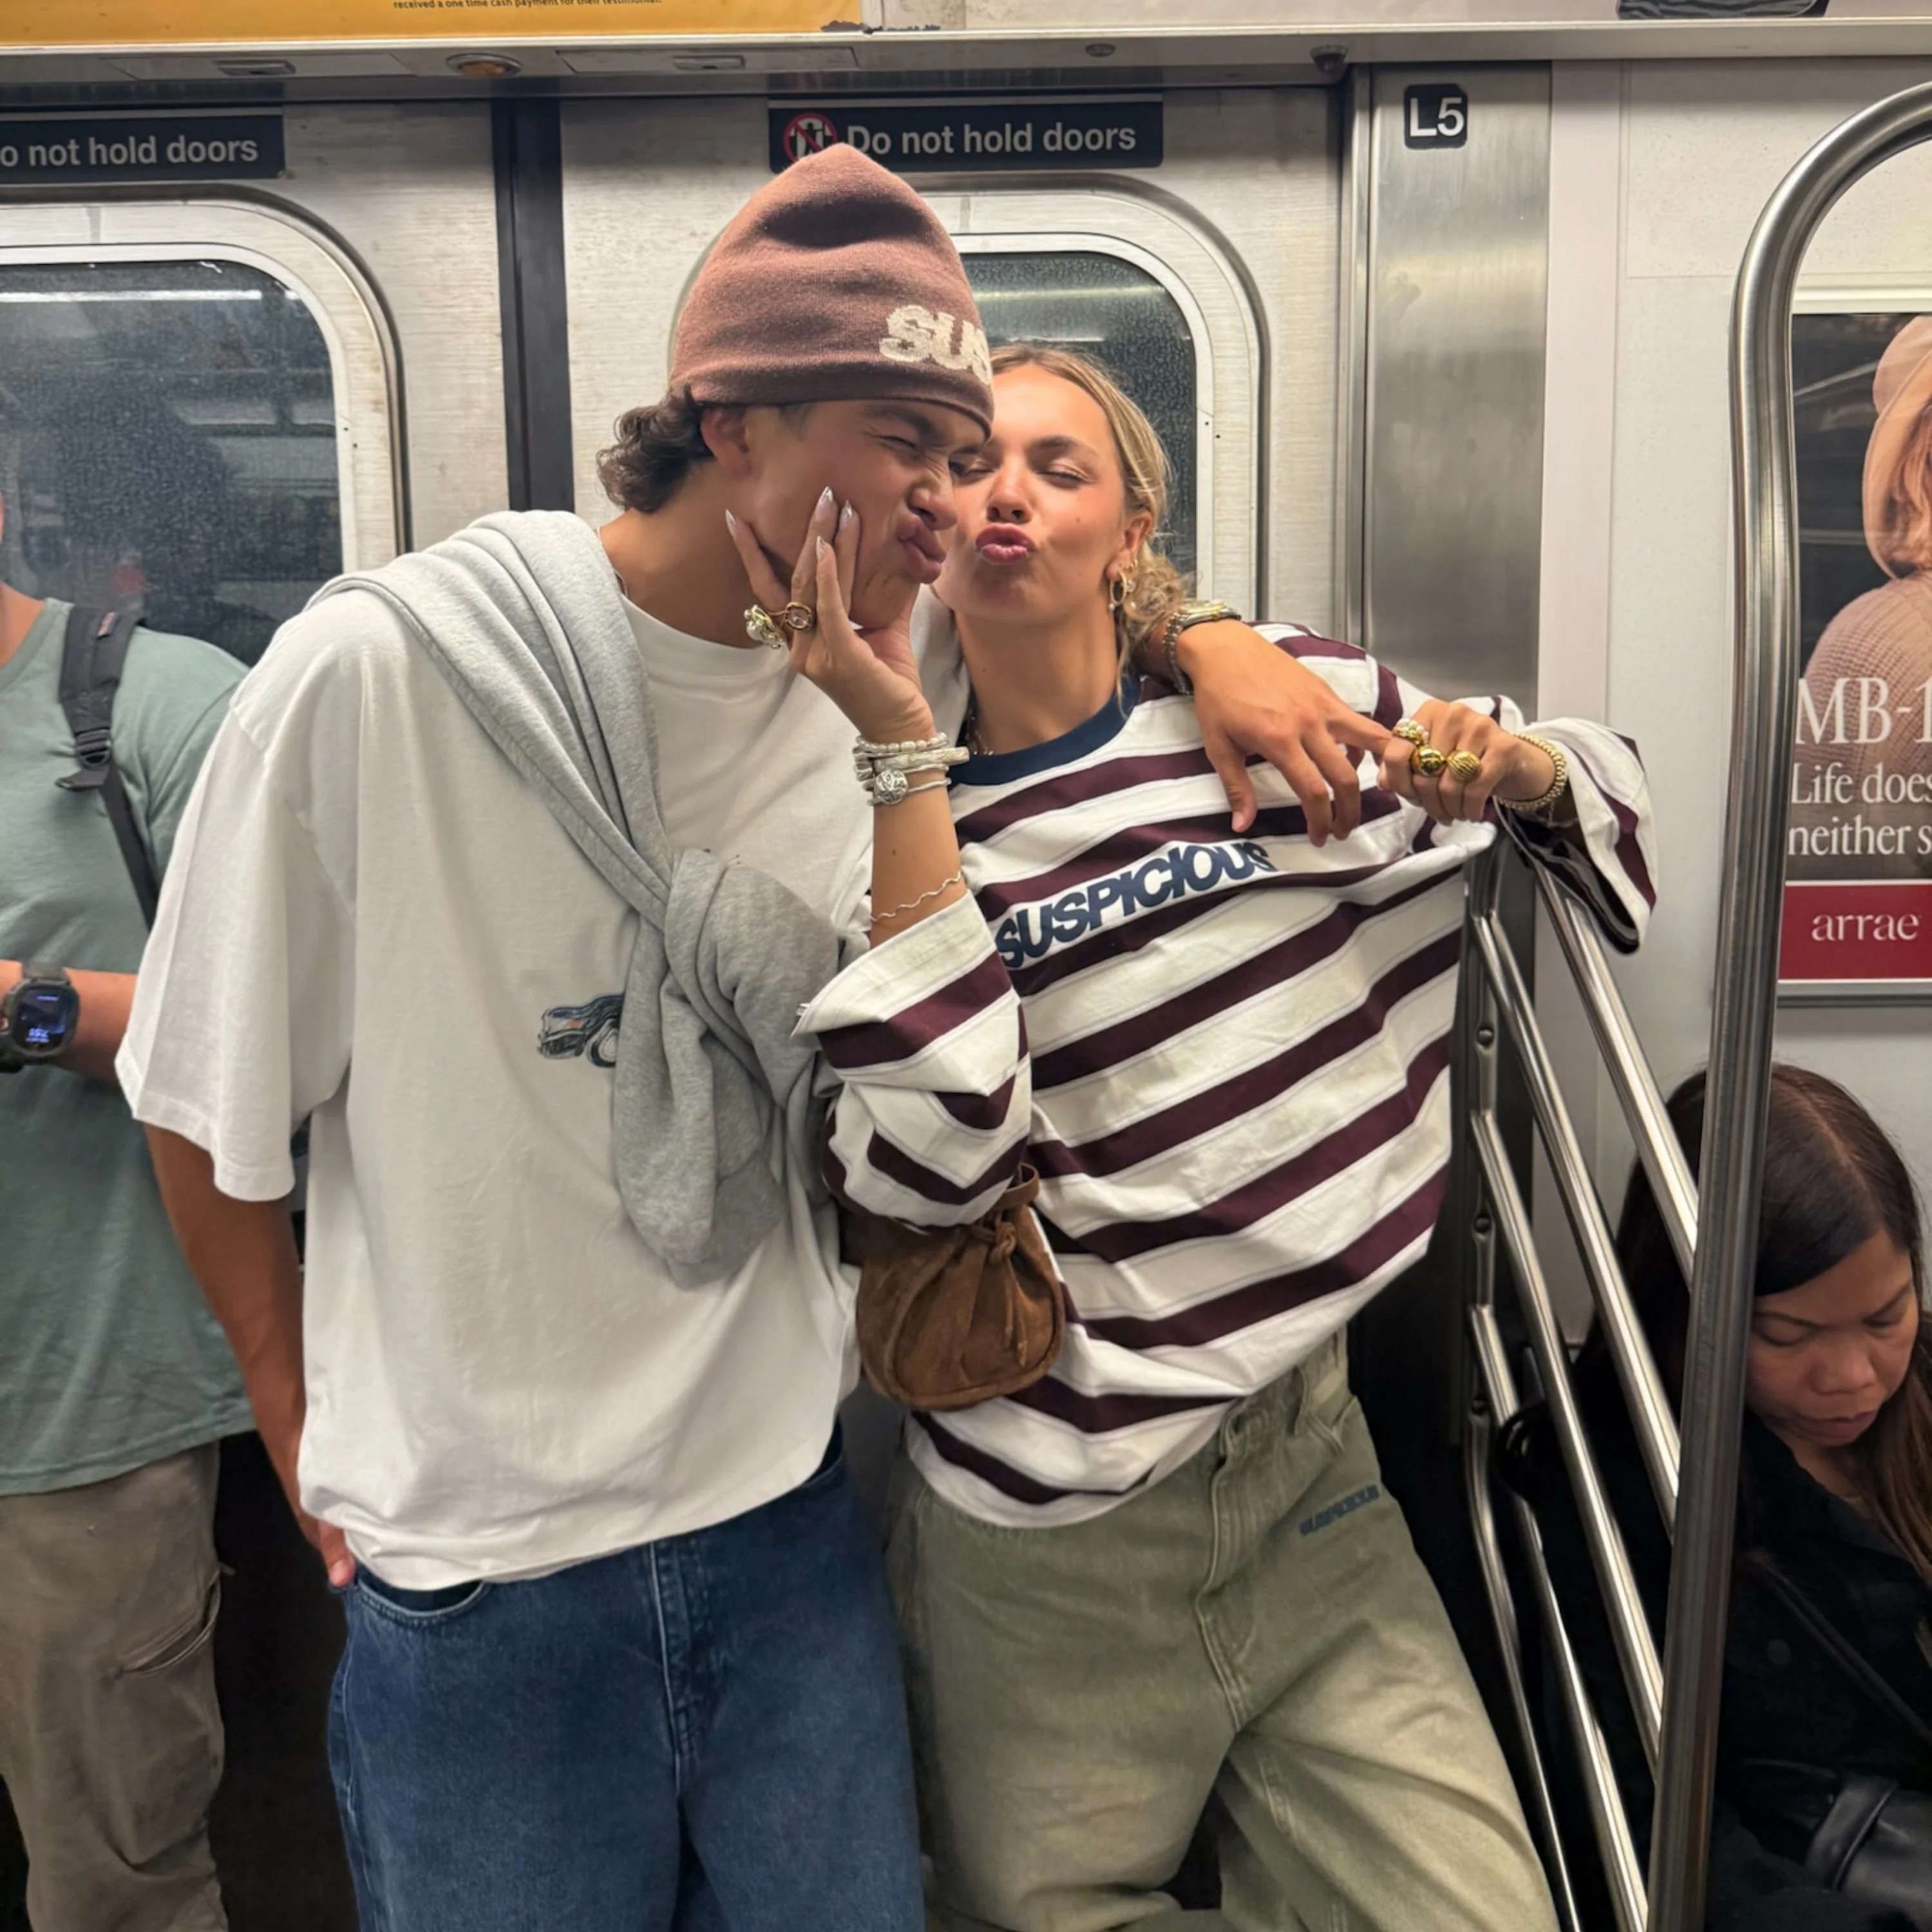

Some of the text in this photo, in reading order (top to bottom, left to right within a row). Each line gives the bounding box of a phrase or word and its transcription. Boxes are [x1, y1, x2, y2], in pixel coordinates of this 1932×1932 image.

[393, 0, 435, 8] received
[1410, 97, 1464, 137] L5
[29, 139, 80, 166] not
[89, 136, 157, 165] hold
[167, 135, 258, 163] doors
[848, 122, 1137, 155] Do not hold doors
[1791, 762, 1853, 804] Life
[1790, 814, 1912, 855] neither
[995, 842, 1278, 967] SUSPICIOUS
[1812, 913, 1920, 941] arrae
